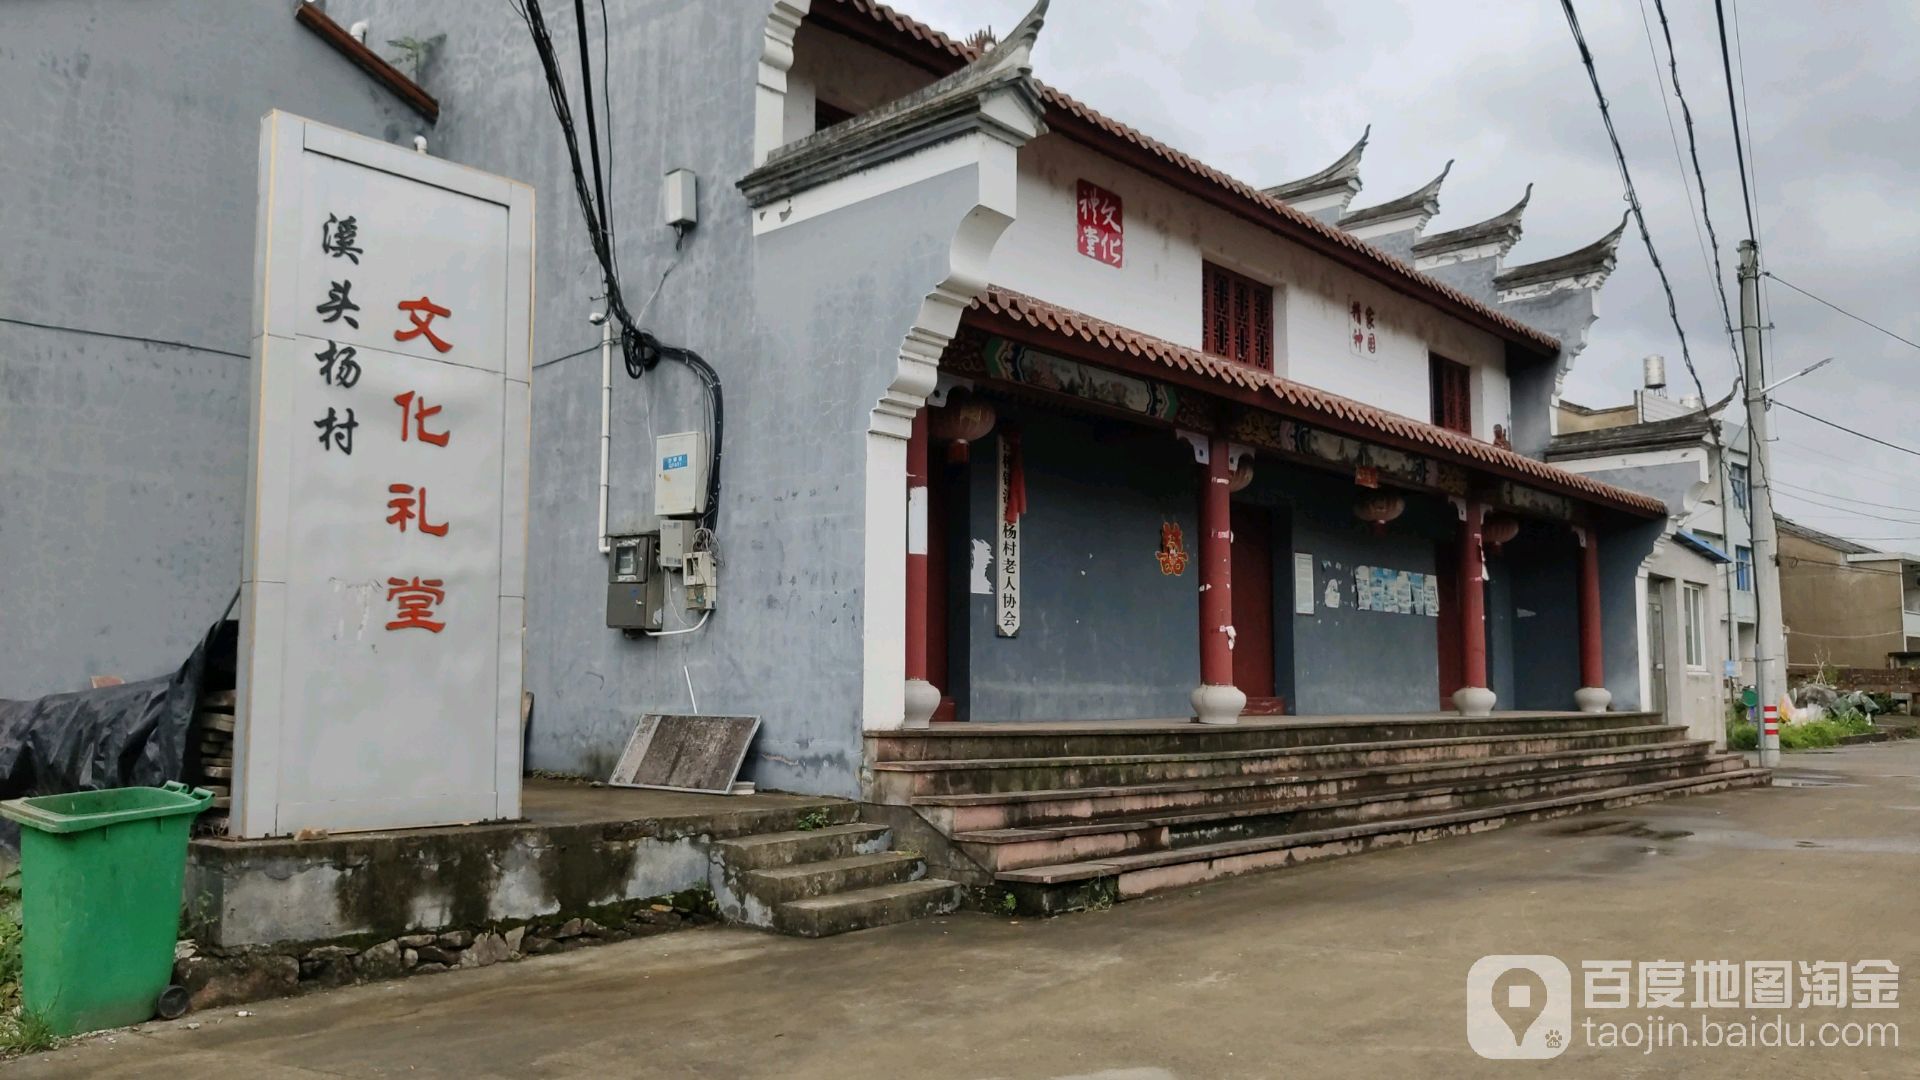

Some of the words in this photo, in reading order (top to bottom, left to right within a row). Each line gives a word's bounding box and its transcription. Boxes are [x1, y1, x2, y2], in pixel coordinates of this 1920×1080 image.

[314, 213, 364, 456] 溪头杨村
[1100, 197, 1123, 264] 文化
[385, 296, 452, 633] 文化礼堂
